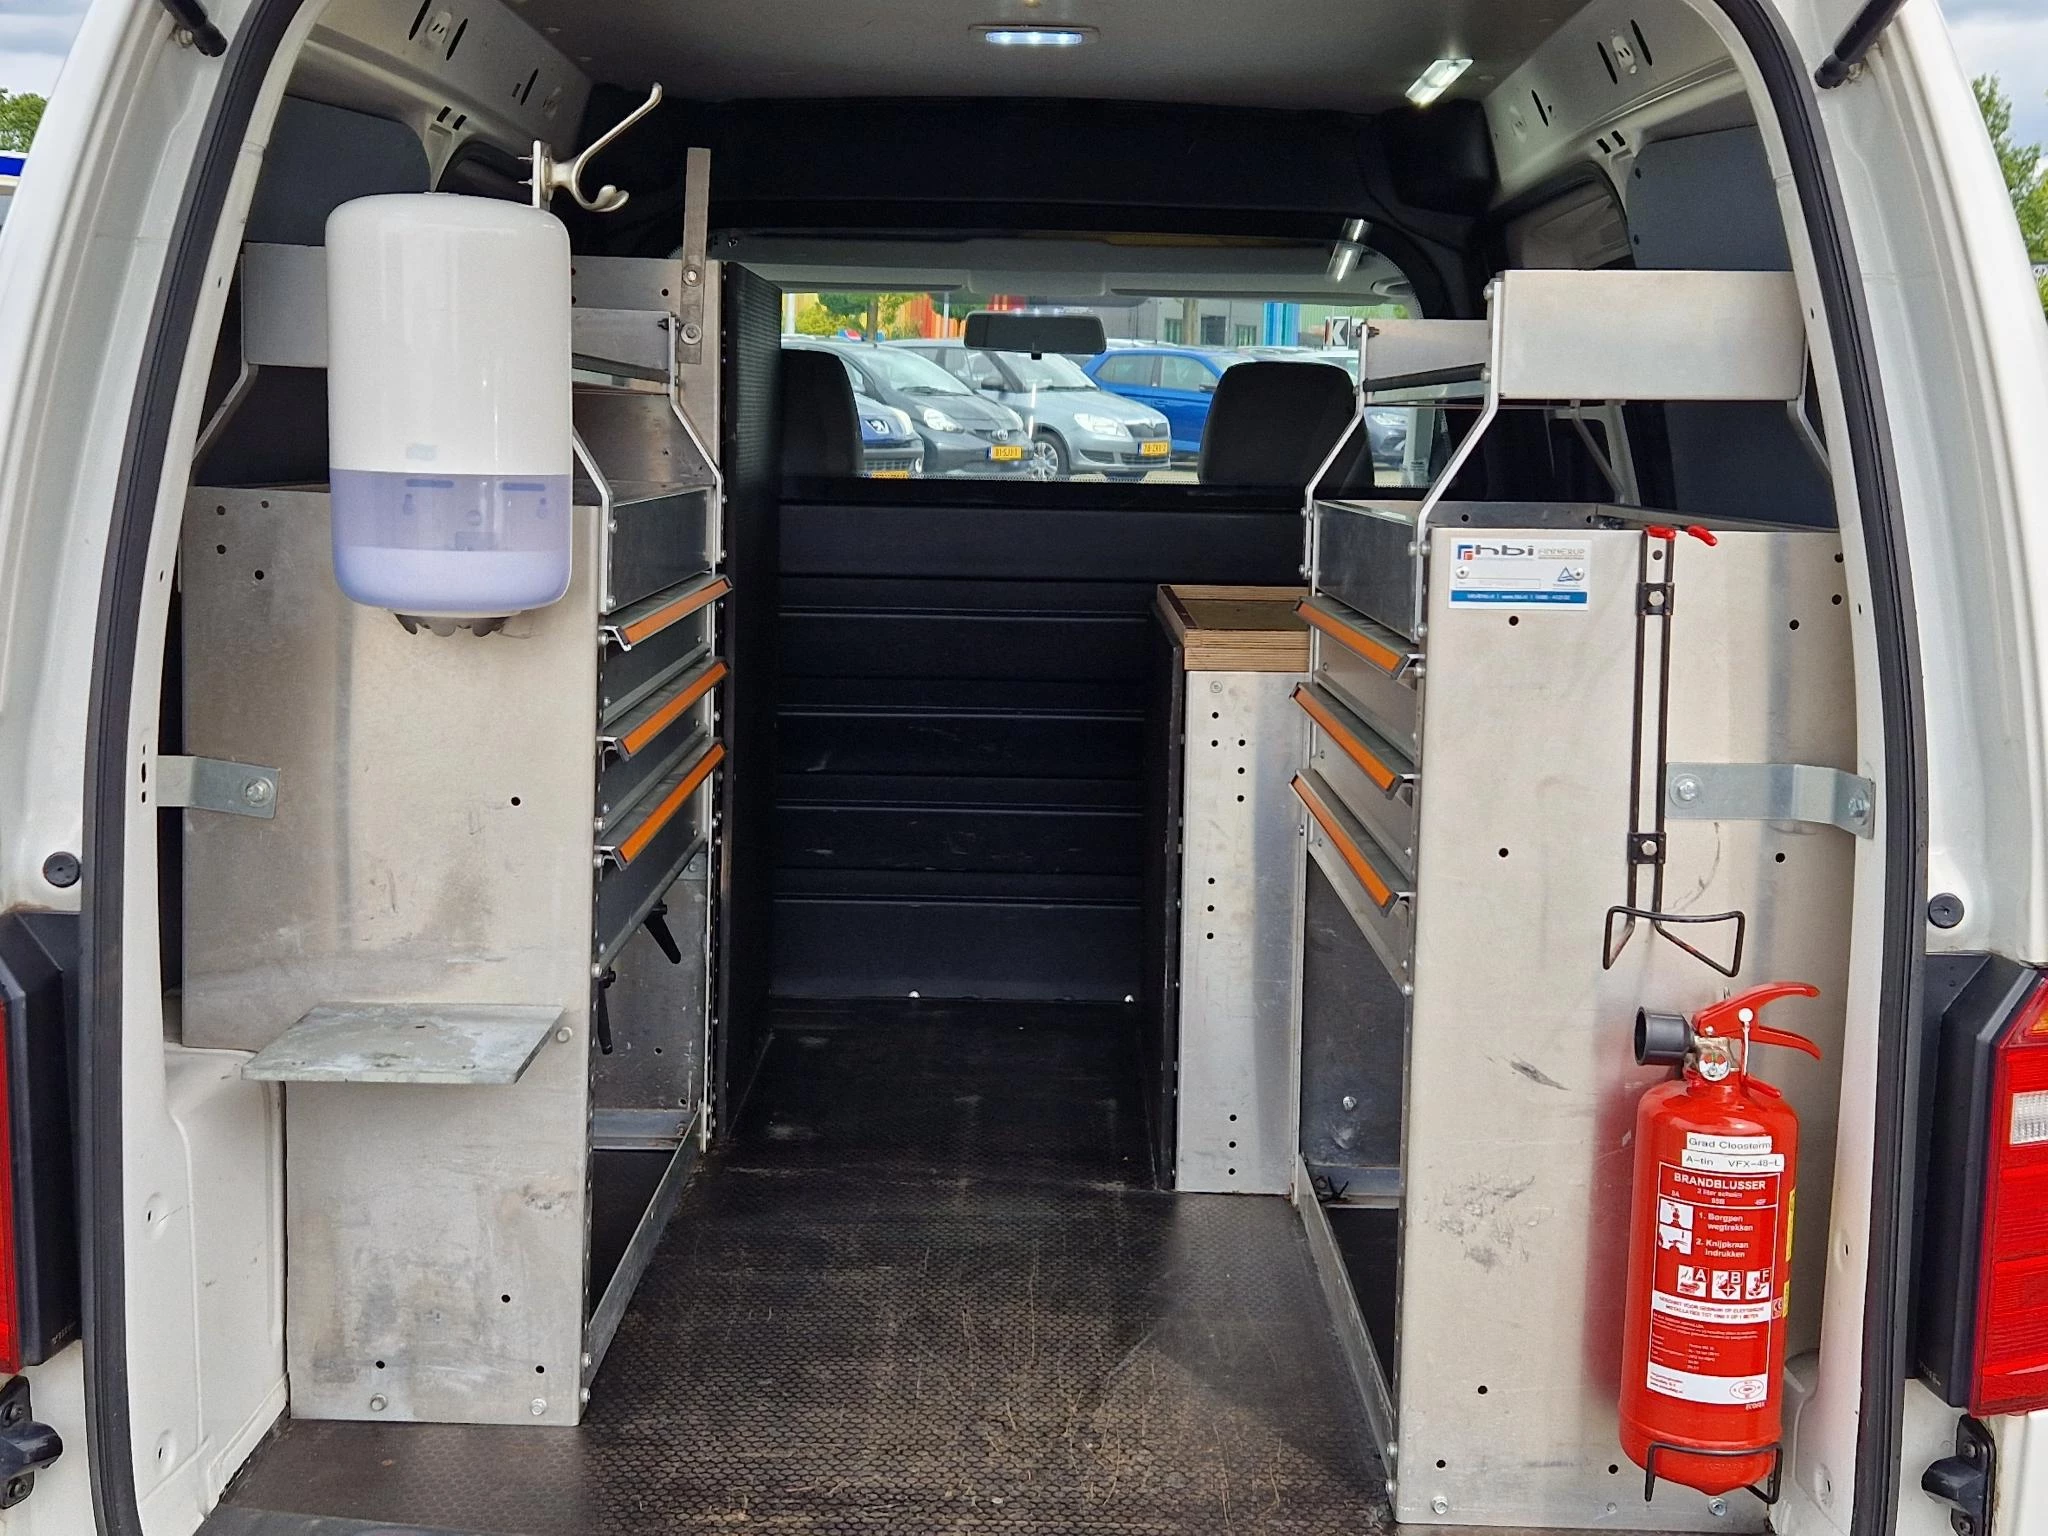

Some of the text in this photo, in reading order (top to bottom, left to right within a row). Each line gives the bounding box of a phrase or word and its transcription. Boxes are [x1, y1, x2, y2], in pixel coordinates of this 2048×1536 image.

[1475, 544, 1534, 556] hbi
[1688, 1137, 1716, 1148] Grad
[1686, 1155, 1781, 1168] A-tin VFX-48-L
[1674, 1172, 1766, 1190] BRANDBLUSSER
[1708, 1213, 1743, 1223] Borgpen
[1707, 1224, 1754, 1232] wegtrekken
[1696, 1238, 1704, 1246] 2.
[1695, 1269, 1707, 1281] A
[1731, 1272, 1741, 1284] B
[1762, 1270, 1770, 1282] F
